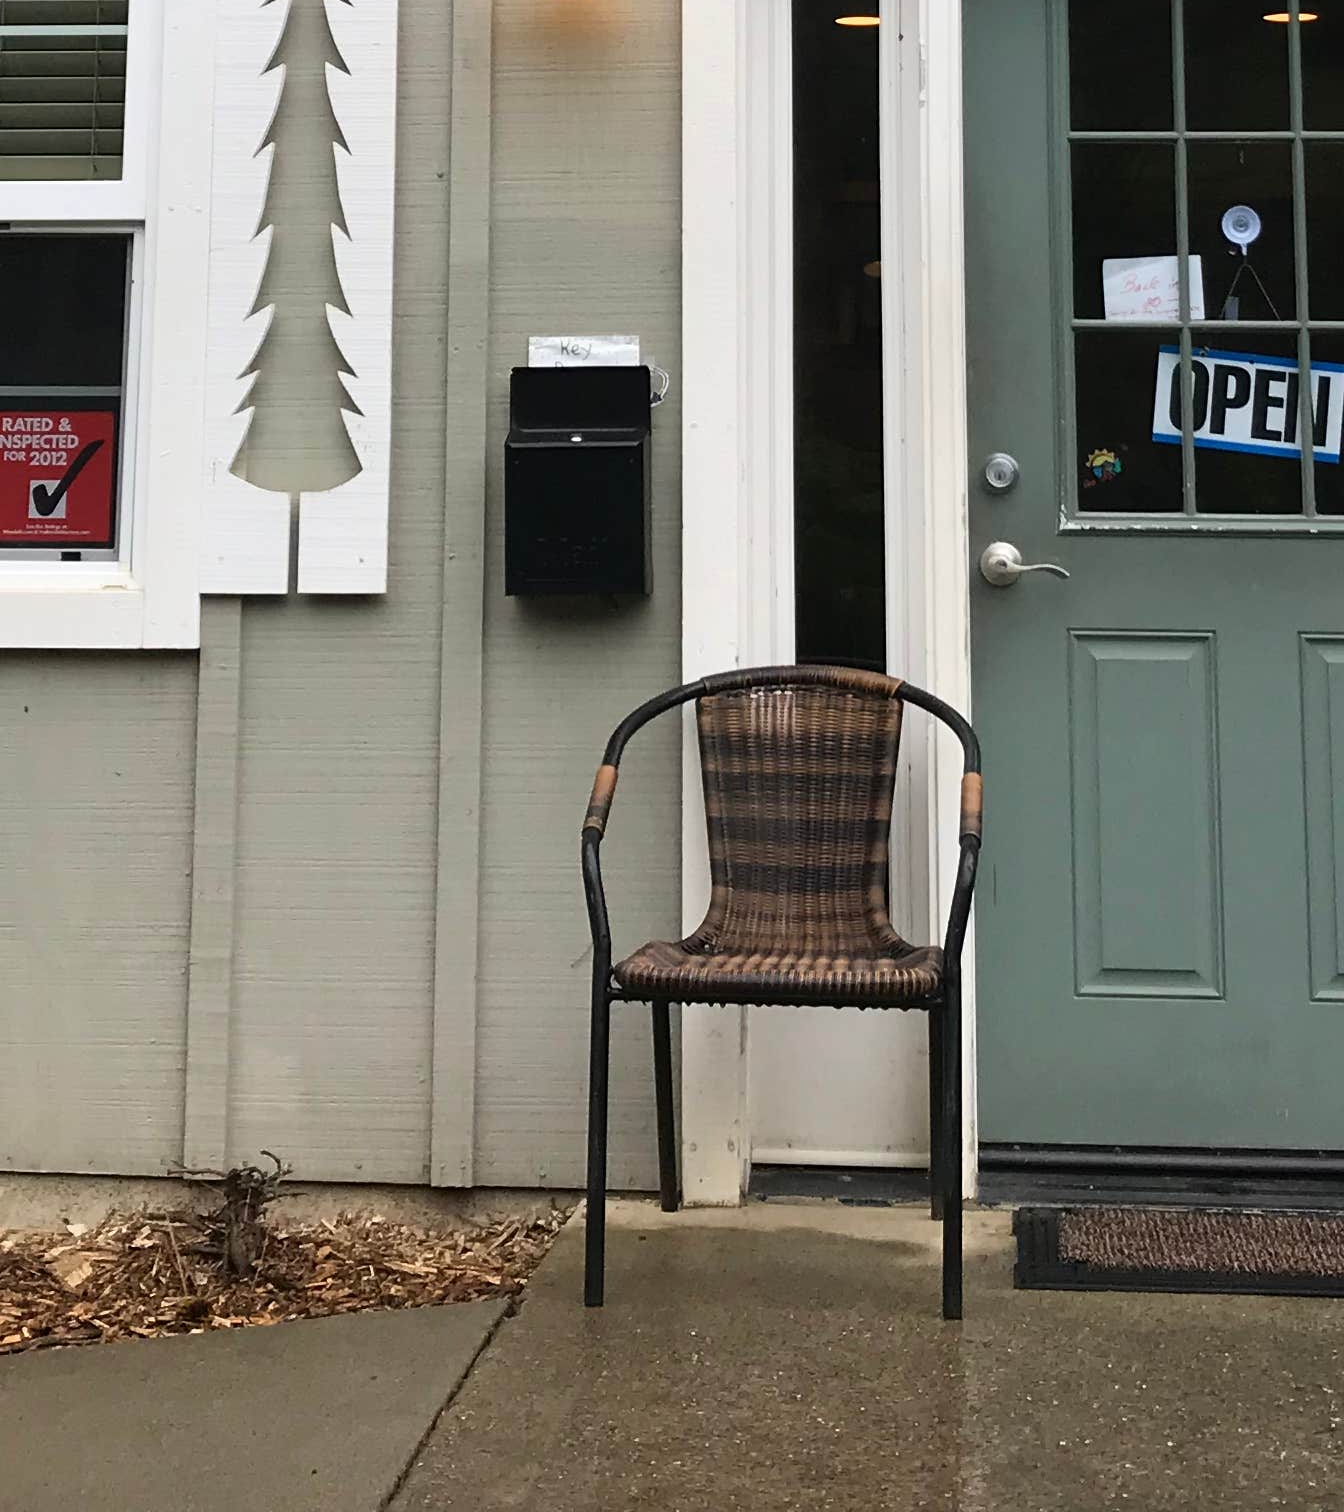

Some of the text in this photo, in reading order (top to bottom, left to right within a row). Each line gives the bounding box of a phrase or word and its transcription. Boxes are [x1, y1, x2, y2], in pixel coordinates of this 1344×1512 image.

[560, 341, 593, 361] Key
[1168, 360, 1331, 448] OPEN
[2, 417, 72, 431] RATED &
[3, 451, 67, 466] FOR 2012
